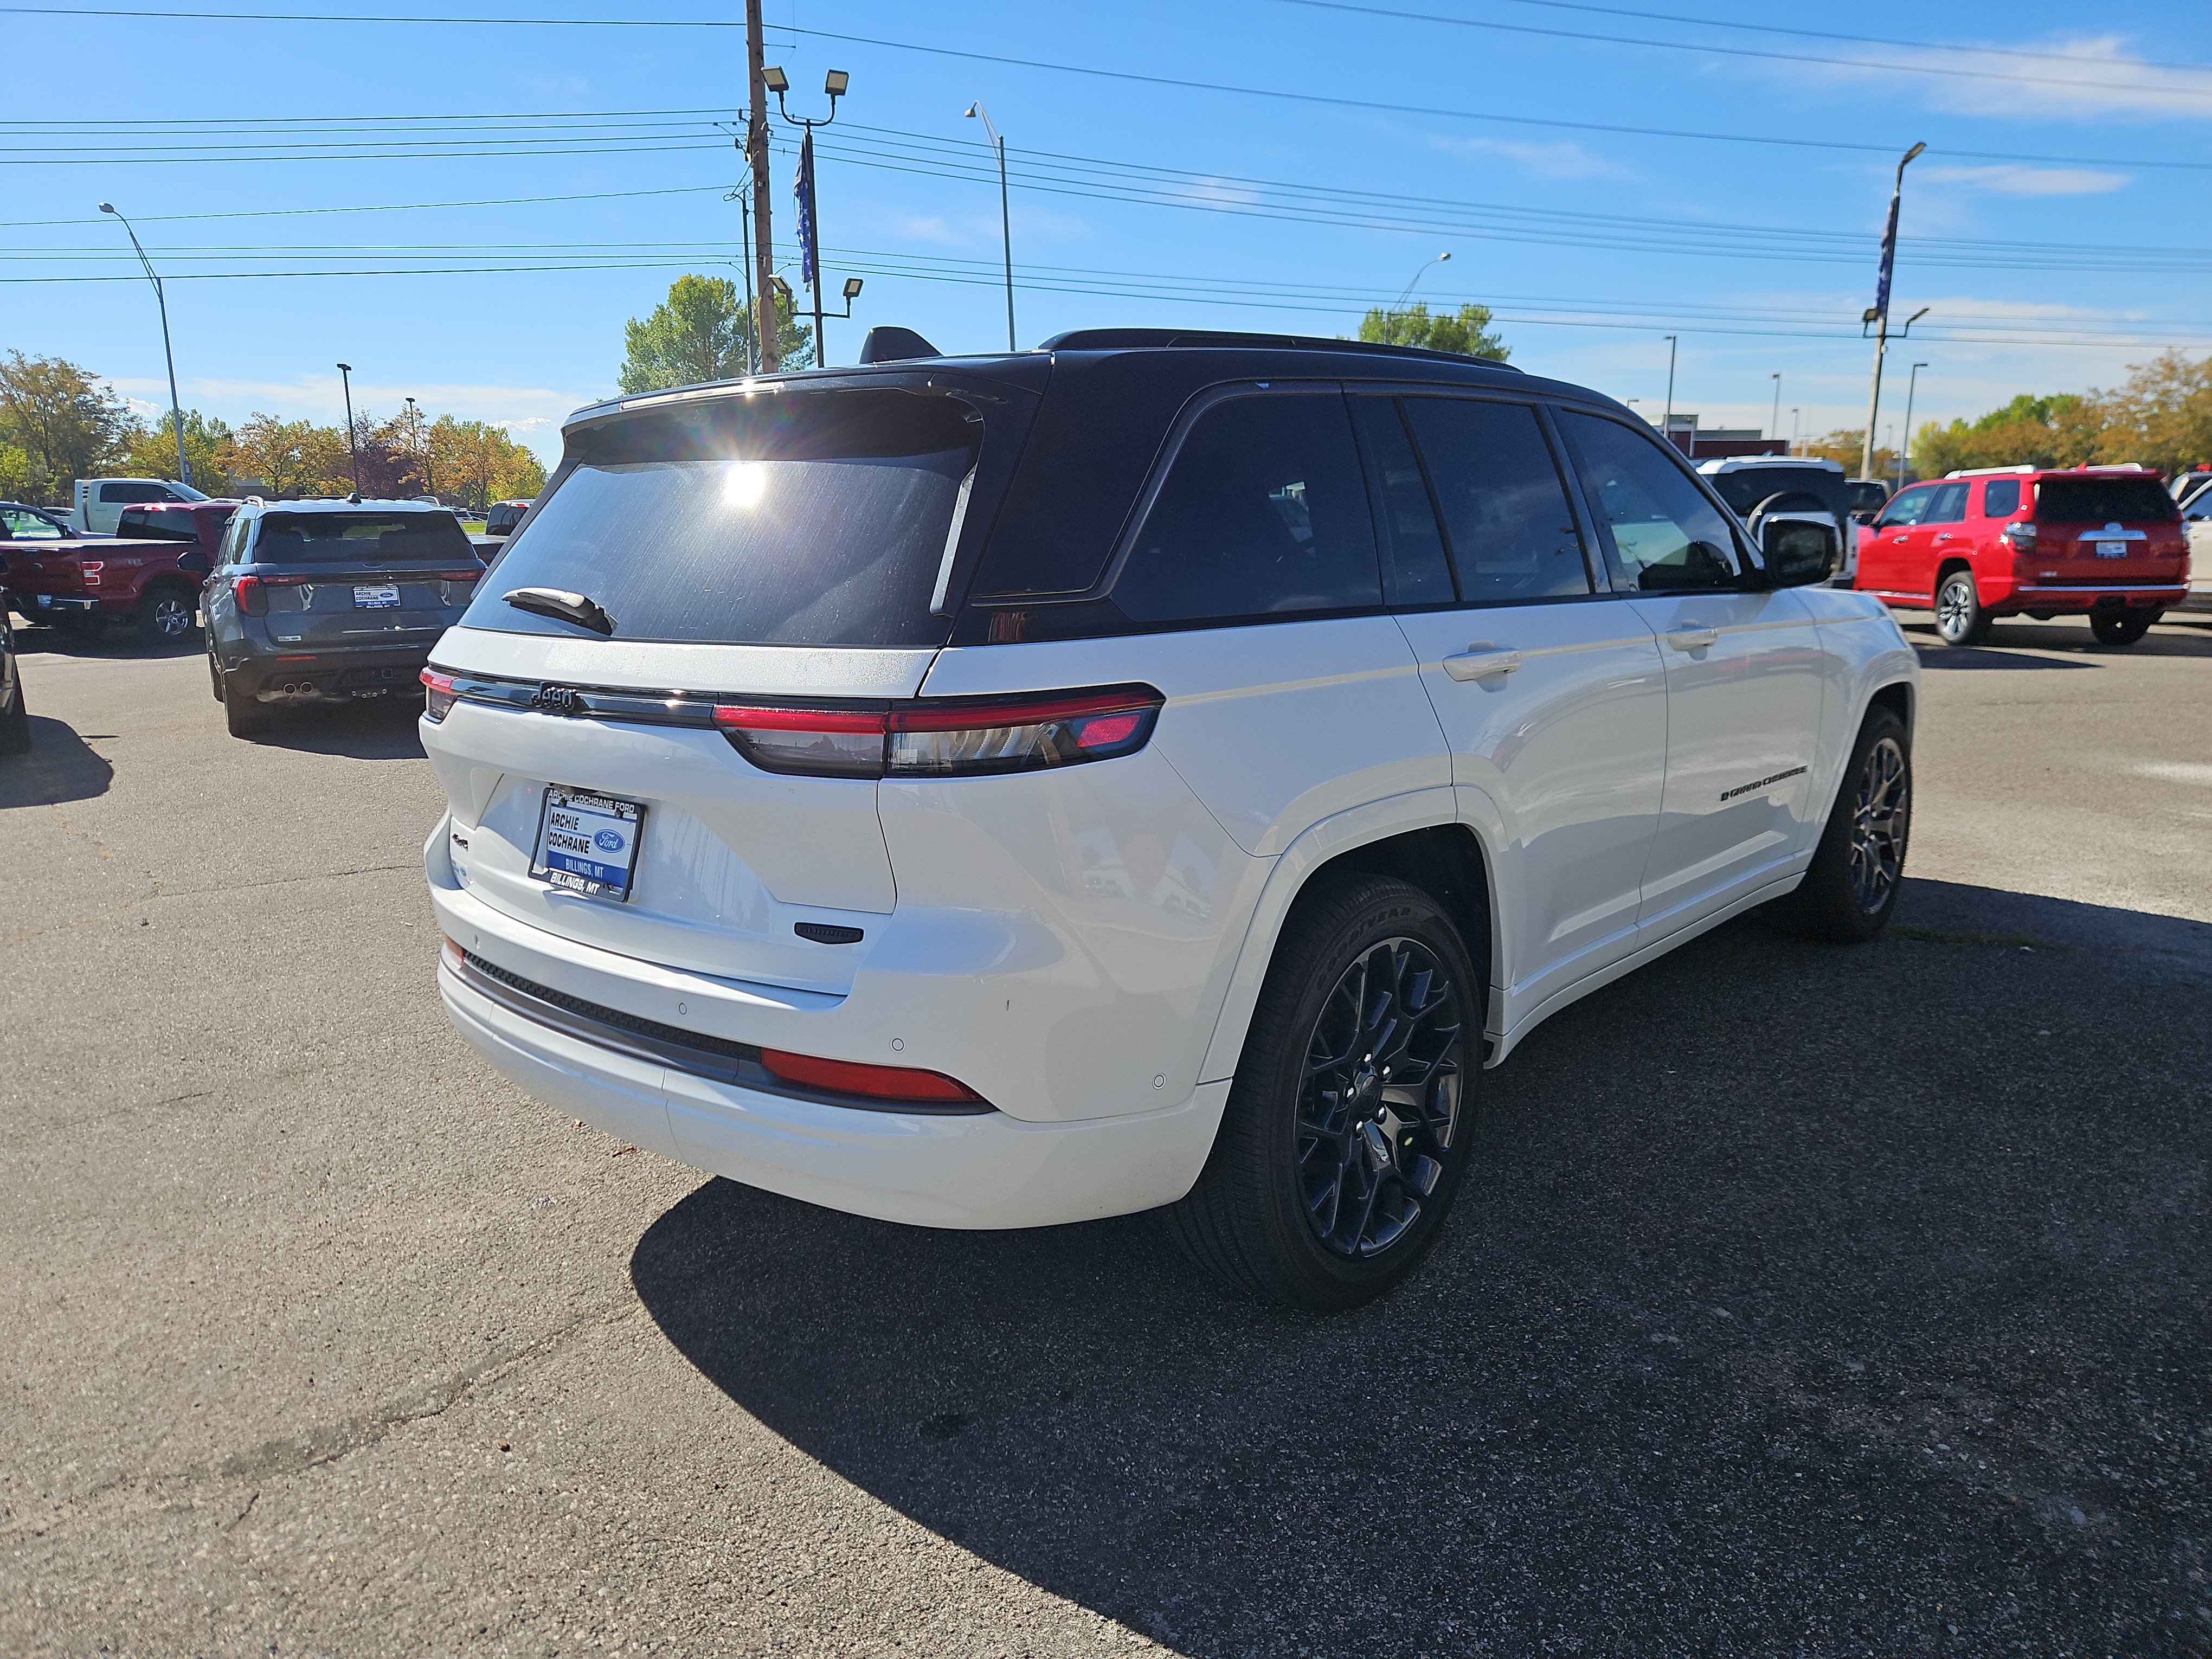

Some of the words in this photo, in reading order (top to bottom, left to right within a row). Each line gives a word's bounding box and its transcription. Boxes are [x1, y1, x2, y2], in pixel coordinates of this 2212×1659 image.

[531, 681, 575, 713] Jeep
[574, 795, 614, 809] COCHRANE
[614, 802, 635, 813] FORD
[550, 812, 580, 831] ARCHIE
[548, 831, 590, 854] COCHRANE
[598, 832, 619, 849] Ford
[565, 858, 594, 877] BILLINGS,
[594, 867, 604, 879] MT
[550, 872, 585, 892] BILLINGS,
[586, 881, 600, 895] MT
